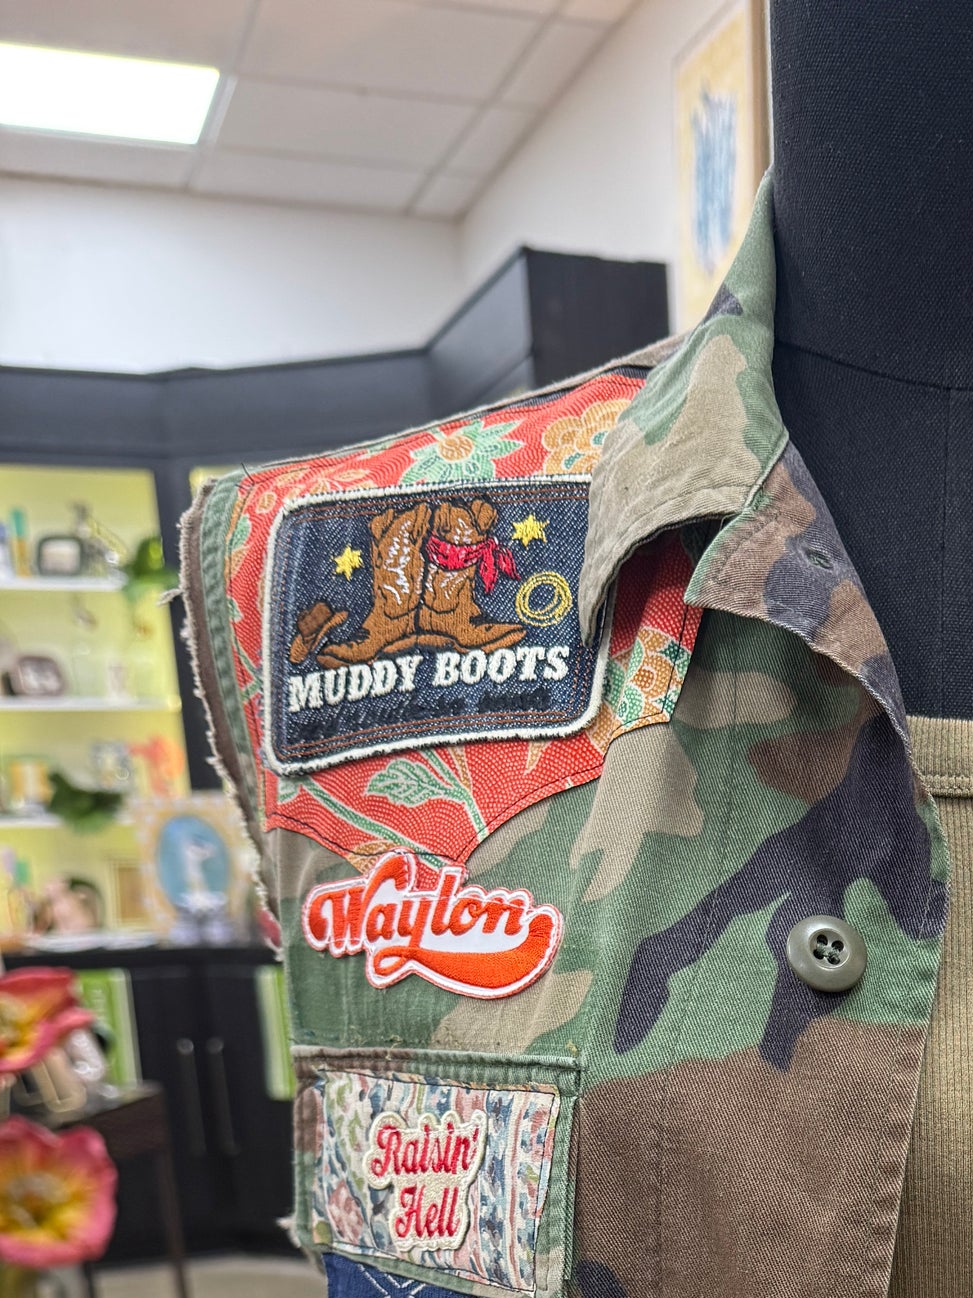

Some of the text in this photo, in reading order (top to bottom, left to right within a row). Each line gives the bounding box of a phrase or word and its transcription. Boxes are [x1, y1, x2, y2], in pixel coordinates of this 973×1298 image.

[288, 646, 570, 712] MUDDY BOOTS
[308, 853, 554, 988] Waylon
[371, 1122, 480, 1178] Raisin'
[395, 1184, 460, 1238] Hell
